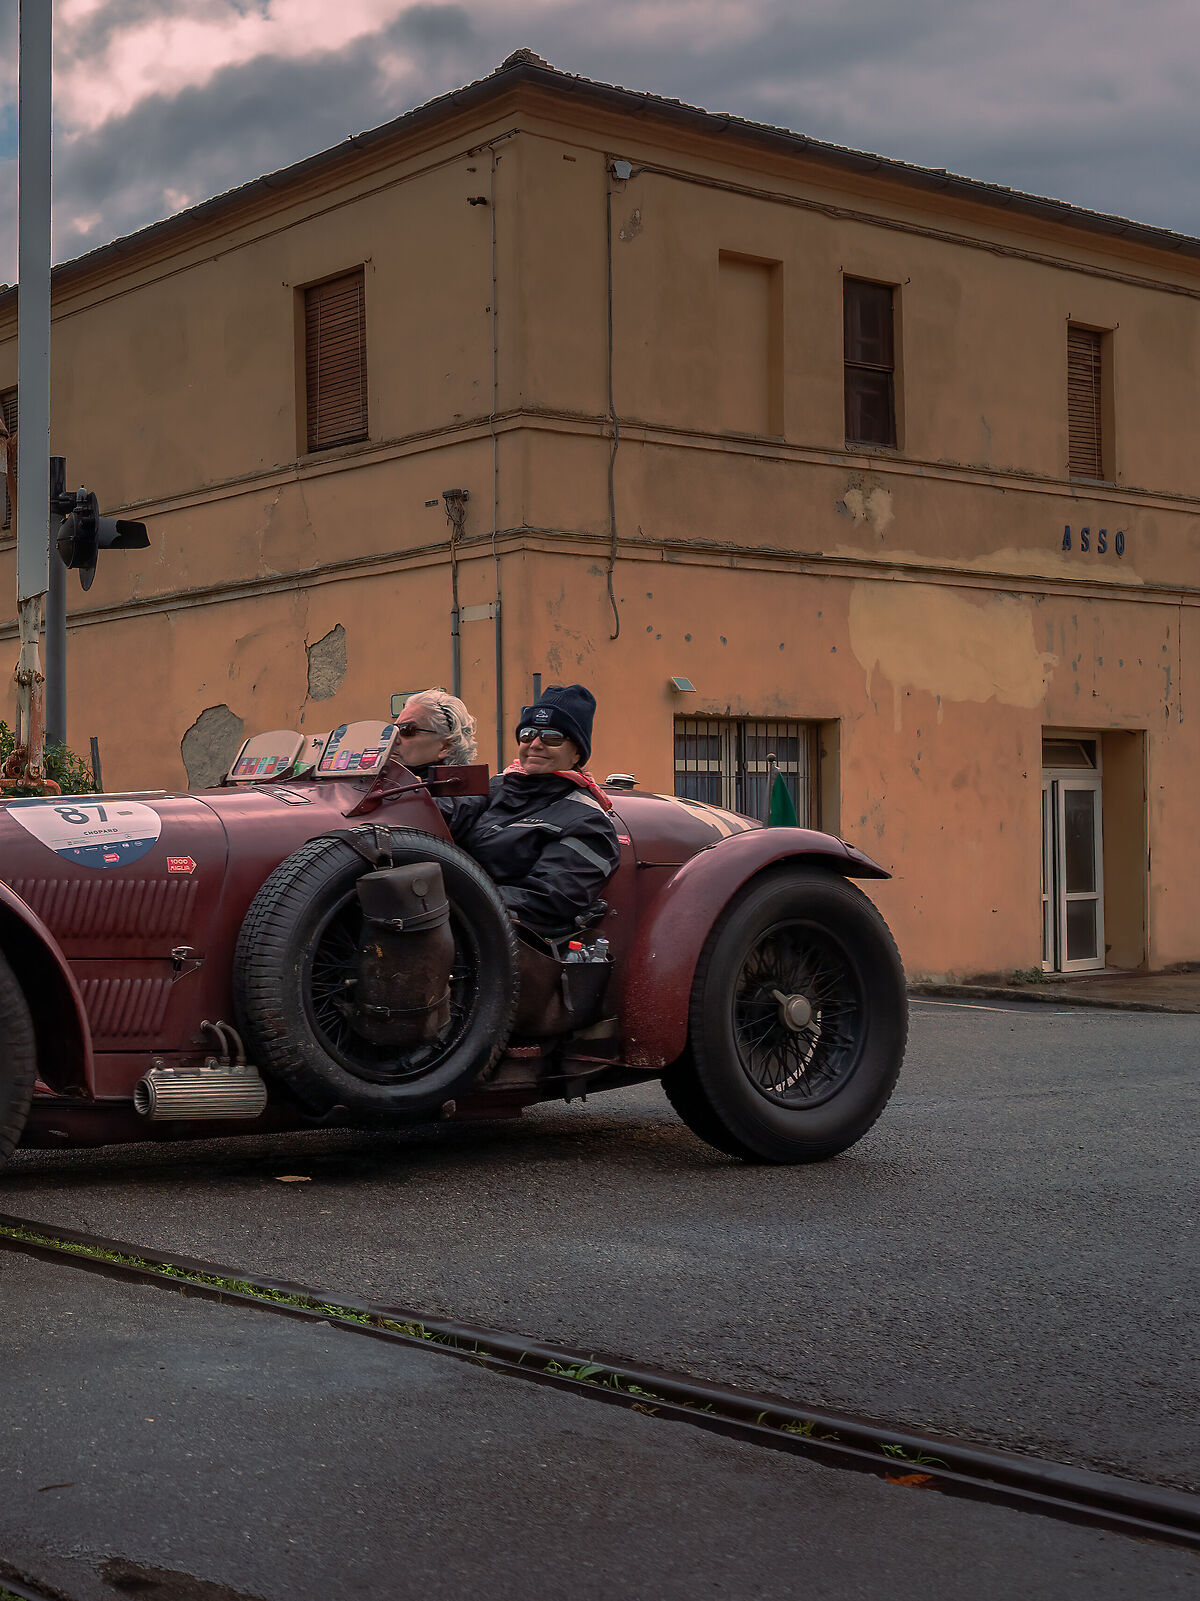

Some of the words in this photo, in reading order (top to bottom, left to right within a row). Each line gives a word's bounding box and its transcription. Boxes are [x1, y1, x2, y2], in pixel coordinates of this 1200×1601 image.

[1062, 525, 1125, 556] ASSO
[53, 805, 108, 825] 87
[83, 828, 119, 836] CHOPARD
